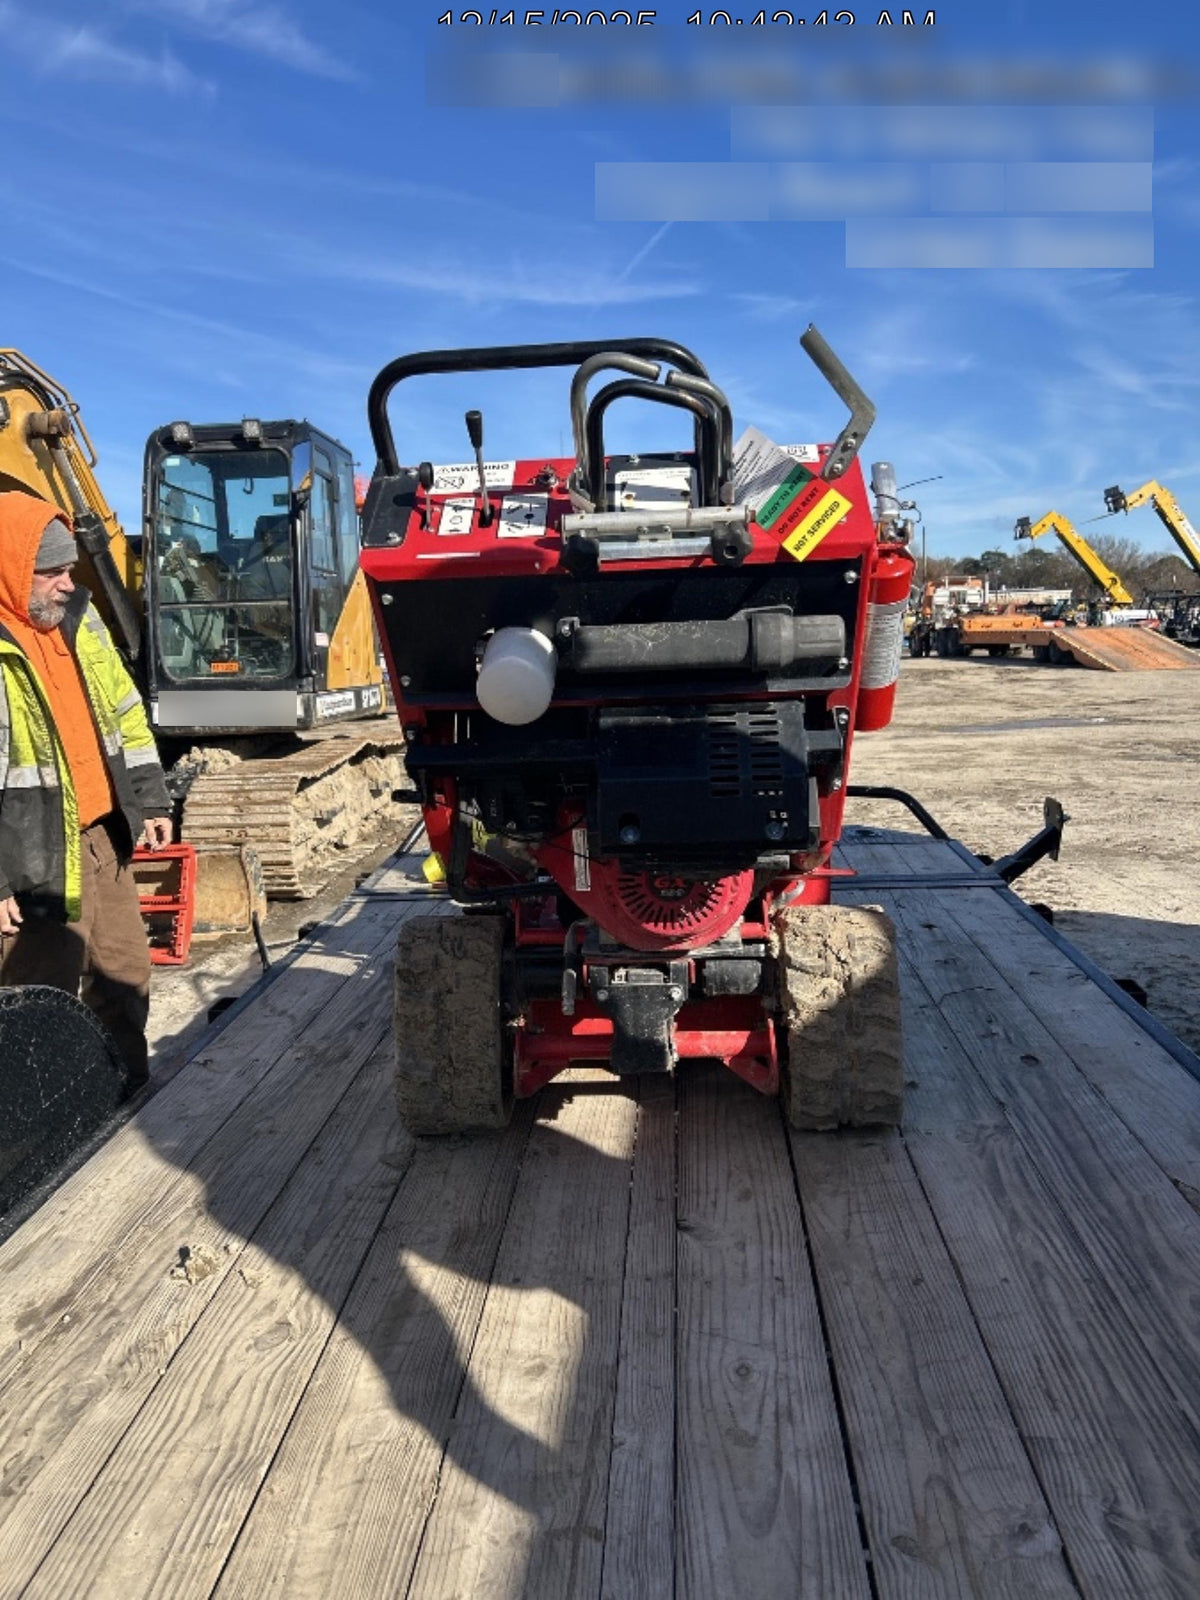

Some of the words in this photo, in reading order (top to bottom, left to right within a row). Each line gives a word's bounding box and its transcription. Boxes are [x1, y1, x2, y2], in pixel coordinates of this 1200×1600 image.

[778, 524, 788, 534] DO
[788, 507, 802, 523] NOT
[801, 486, 819, 507] RENT
[793, 535, 809, 552] NOT
[807, 501, 840, 537] SERVICED
